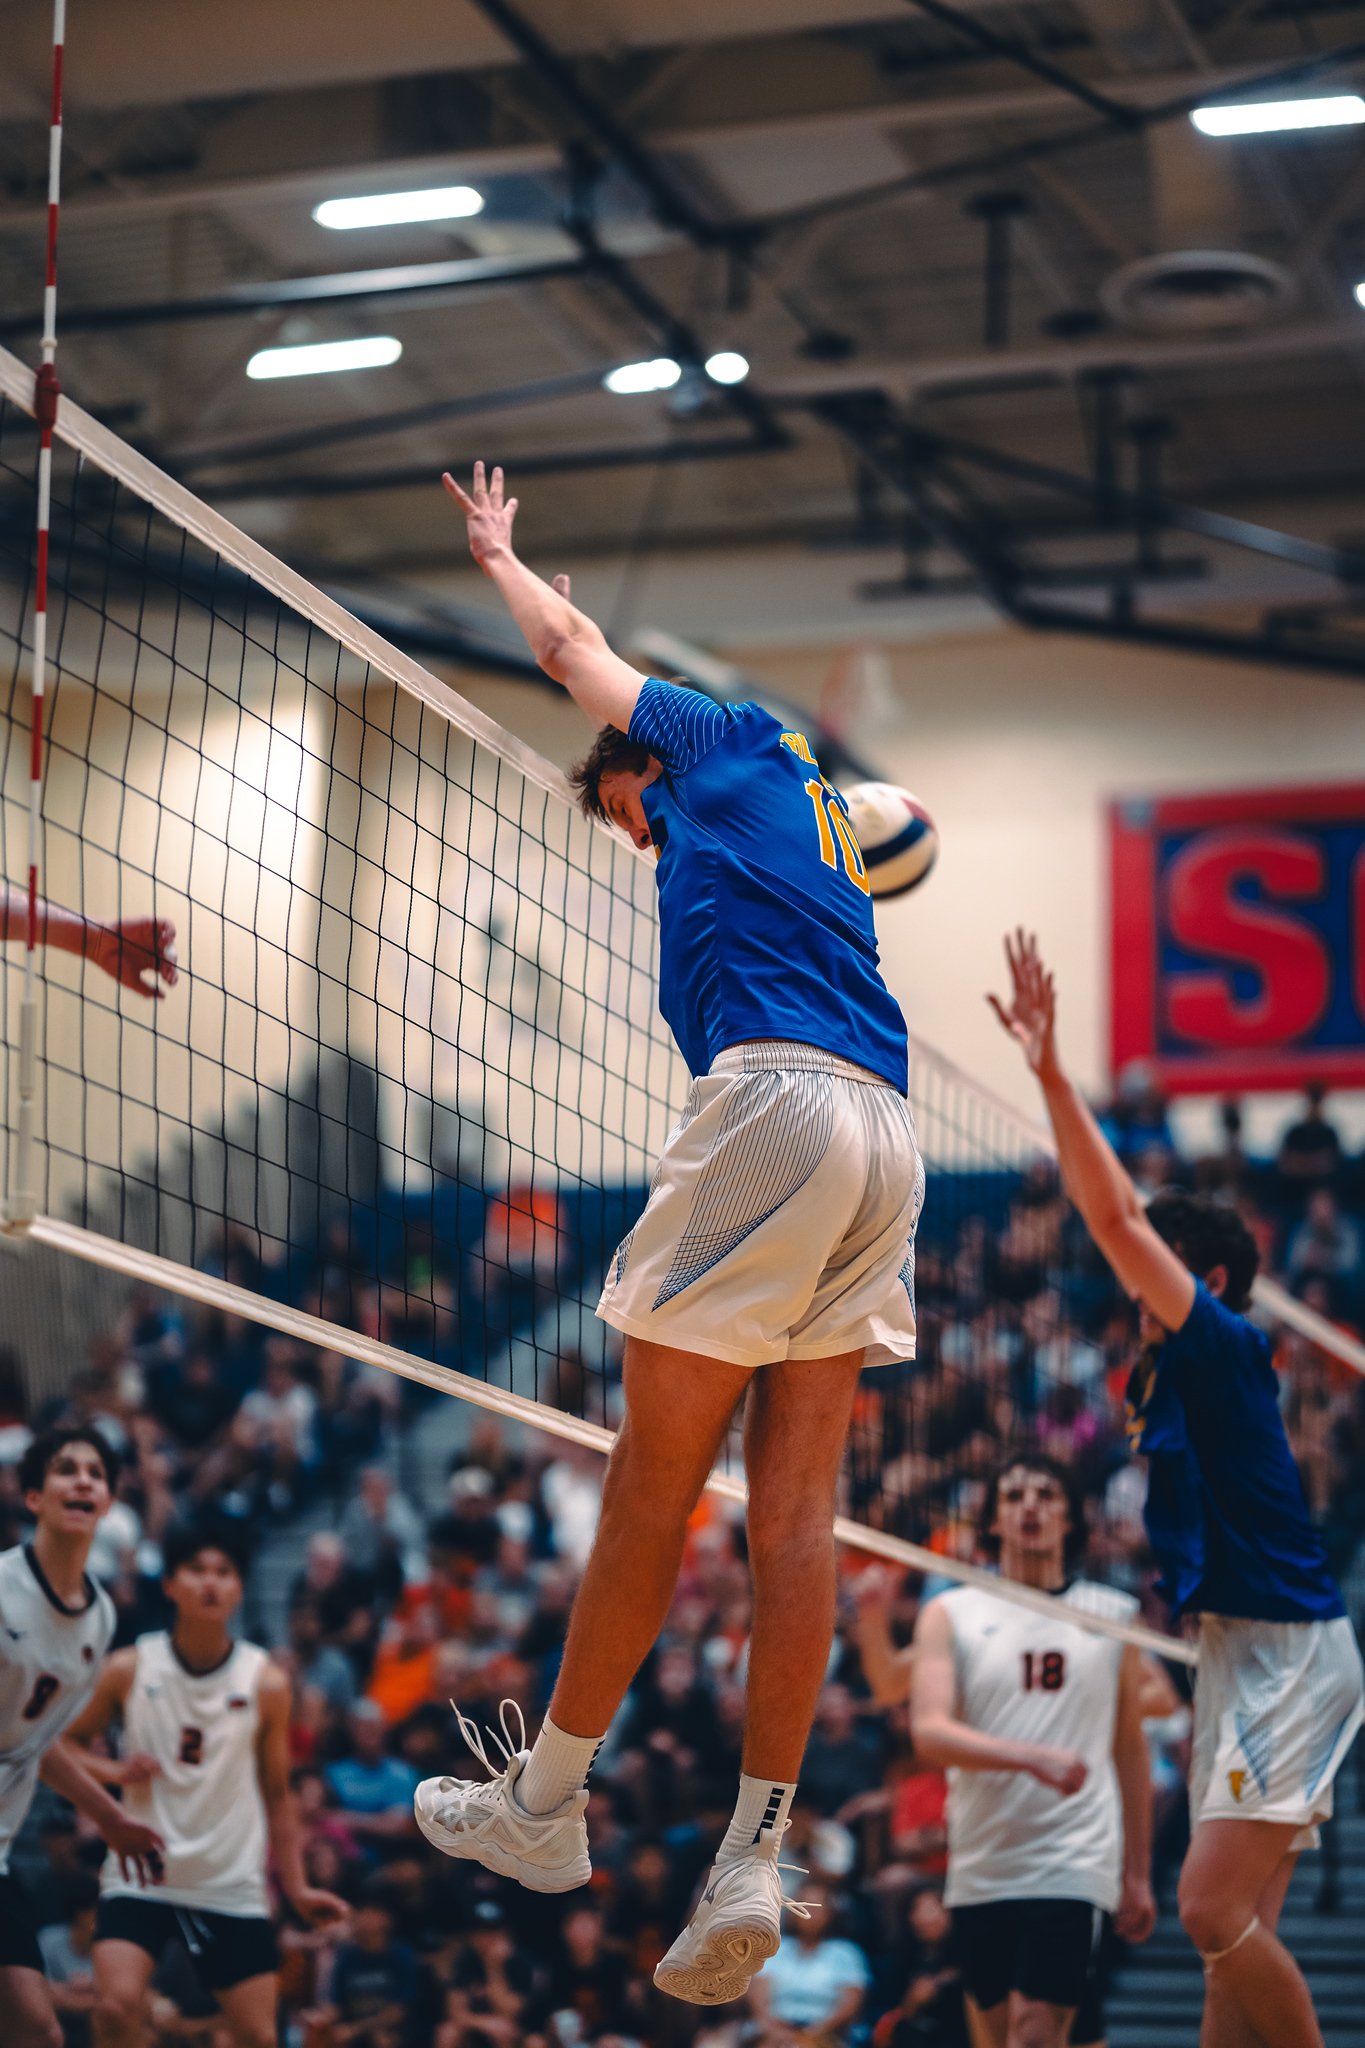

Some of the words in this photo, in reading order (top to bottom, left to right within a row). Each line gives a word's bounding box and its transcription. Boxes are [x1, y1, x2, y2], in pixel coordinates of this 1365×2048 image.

[804, 778, 871, 897] 10
[1167, 827, 1365, 1048] S
[1020, 1651, 1066, 1693] 18
[179, 1725, 204, 1765] 2
